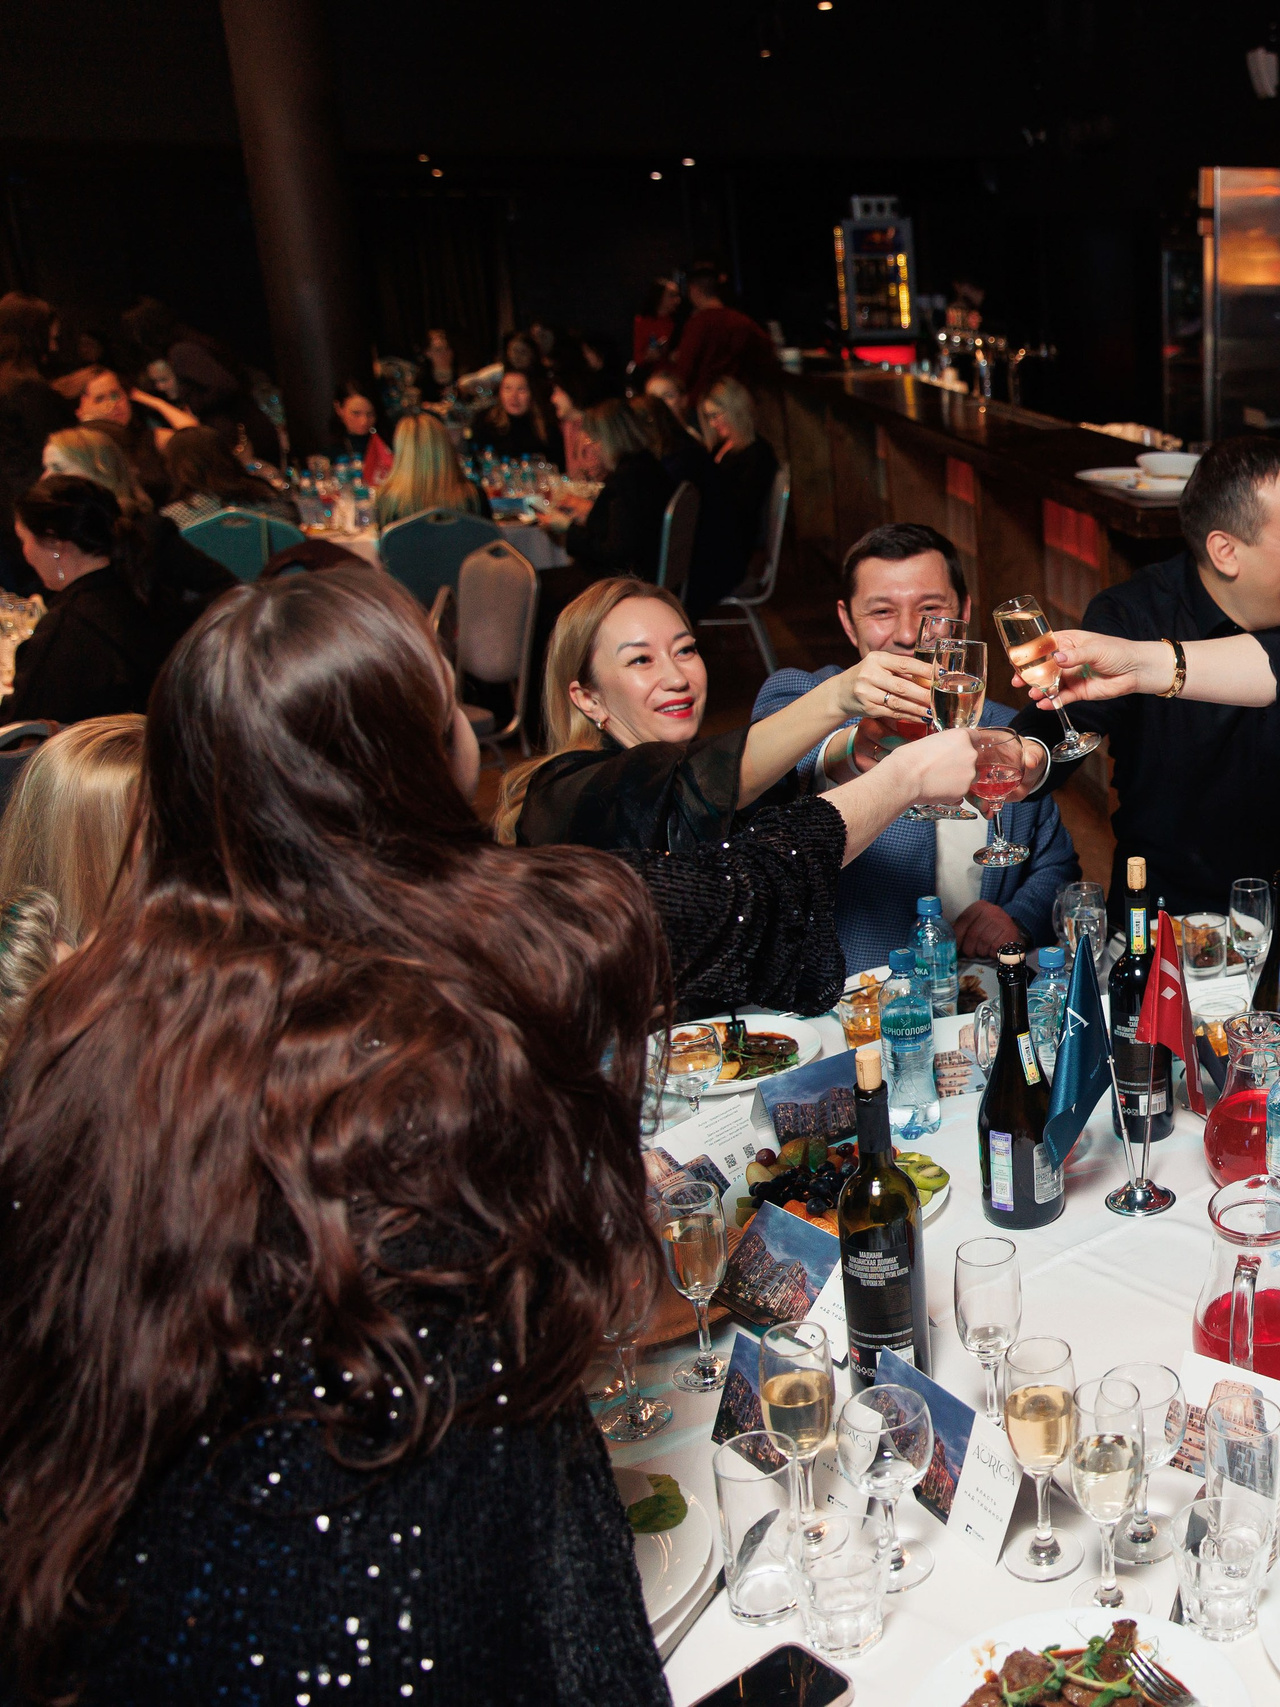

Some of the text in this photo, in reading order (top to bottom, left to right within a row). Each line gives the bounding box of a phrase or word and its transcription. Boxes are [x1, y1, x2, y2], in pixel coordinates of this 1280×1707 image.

[972, 1444, 1016, 1486] AURICA
[964, 1490, 975, 1501] НАД
[976, 1486, 997, 1506] ВЛАСТЬ
